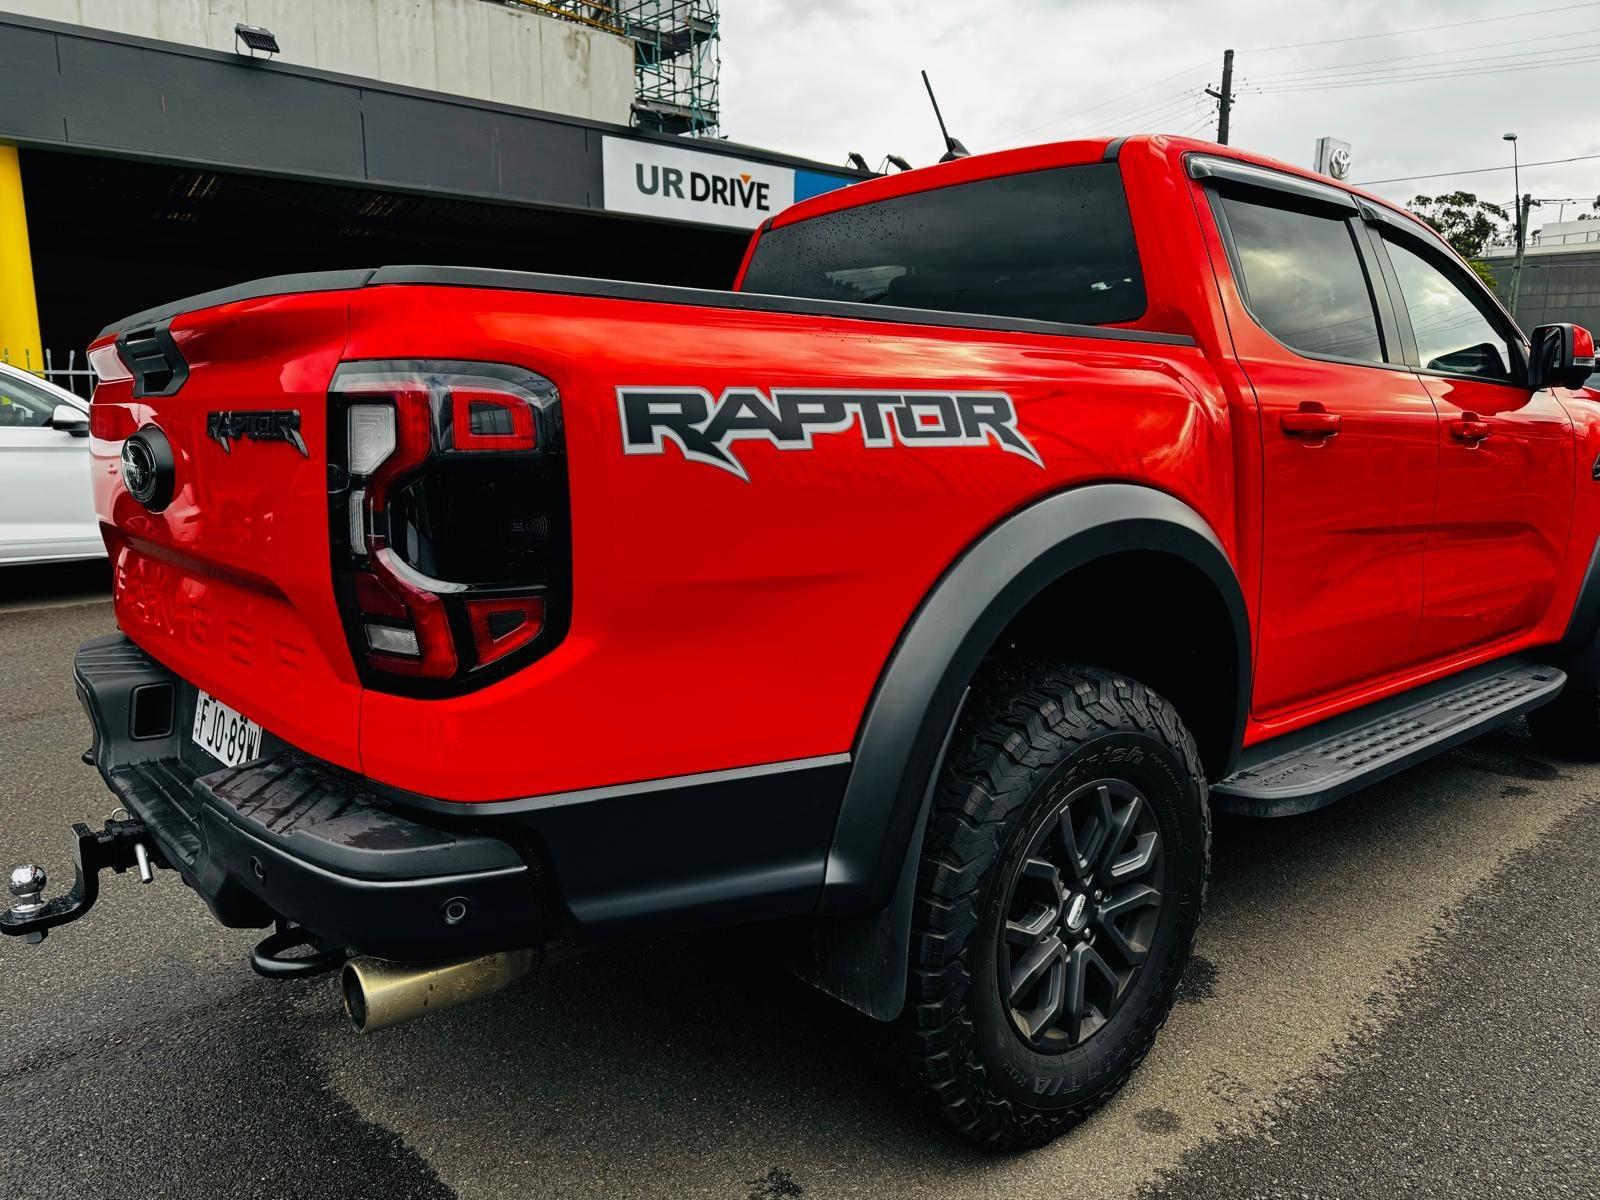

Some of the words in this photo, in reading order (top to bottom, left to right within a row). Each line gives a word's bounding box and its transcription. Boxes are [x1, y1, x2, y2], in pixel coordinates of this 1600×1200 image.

[635, 162, 685, 200] UR
[690, 171, 770, 211] DRIVE
[206, 409, 309, 458] RAPTOR
[614, 385, 1046, 483] RAPTOR
